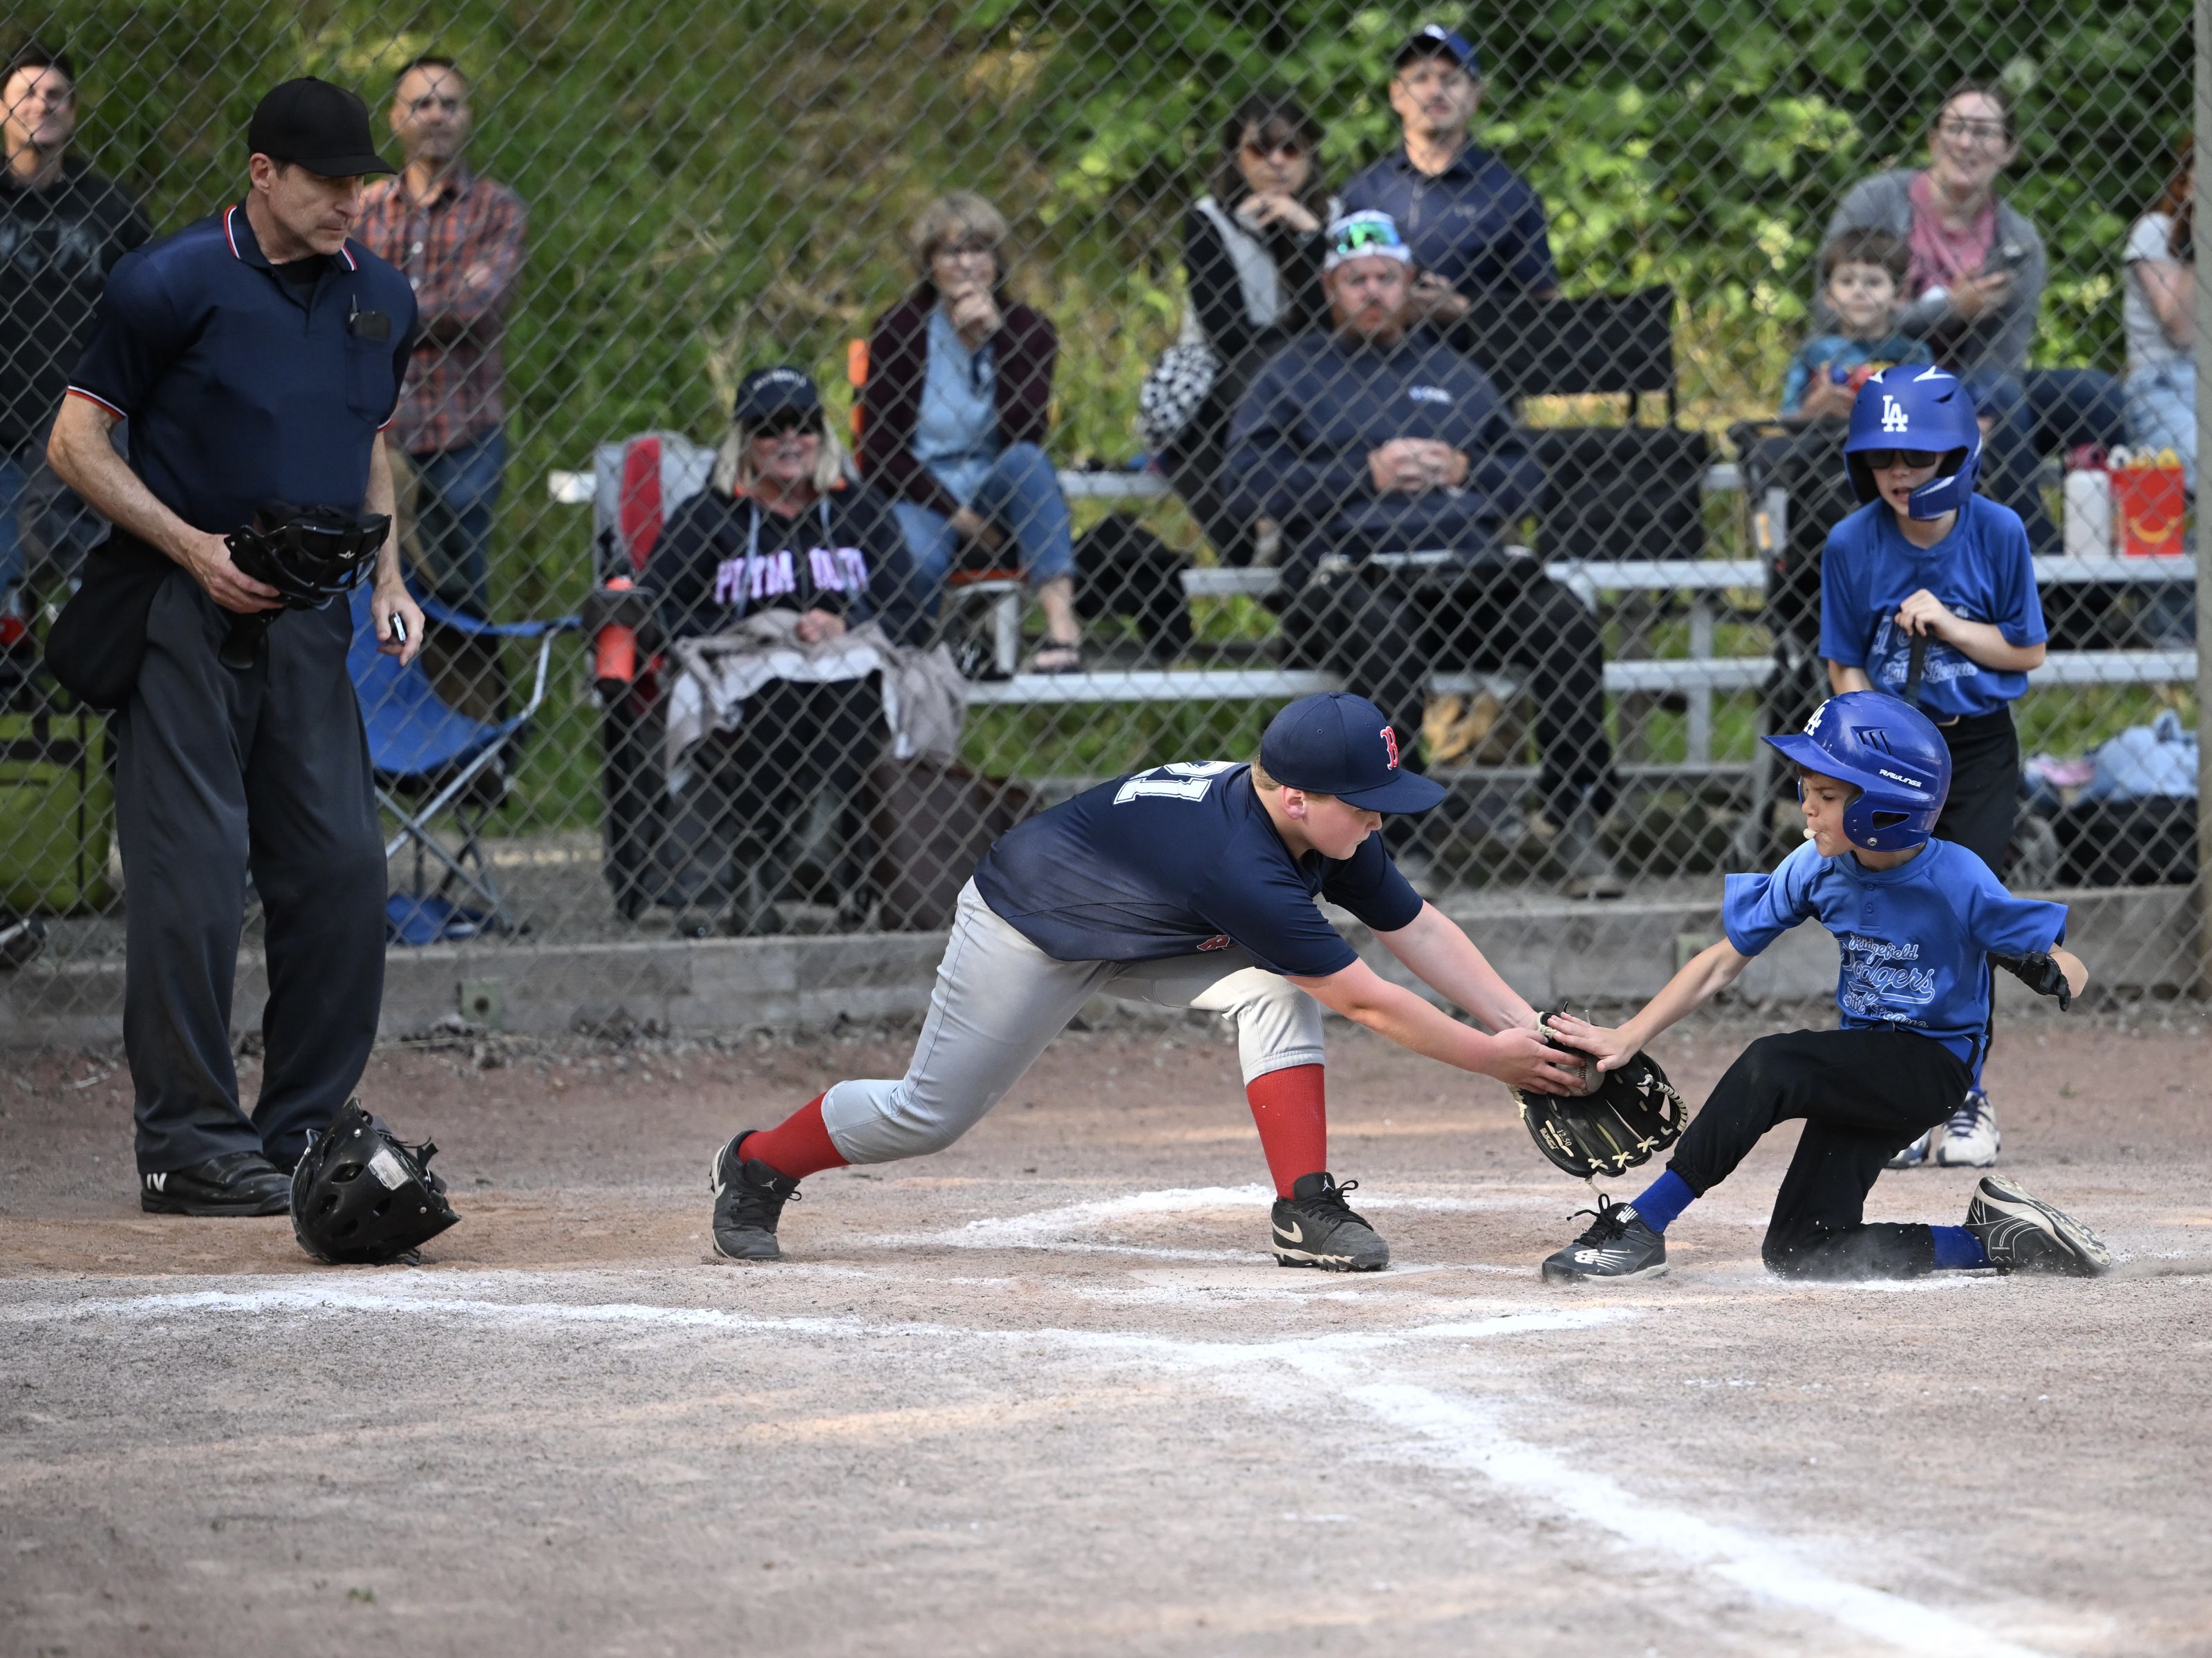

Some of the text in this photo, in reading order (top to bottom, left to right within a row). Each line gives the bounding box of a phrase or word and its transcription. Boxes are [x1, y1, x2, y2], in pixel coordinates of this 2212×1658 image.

[1881, 395, 1909, 432] LA
[1380, 726, 1399, 770] B
[1879, 769, 1922, 788] RAWLINGS
[1848, 932, 1919, 965] Ridgefield
[1556, 1129, 1573, 1147] 12.50
